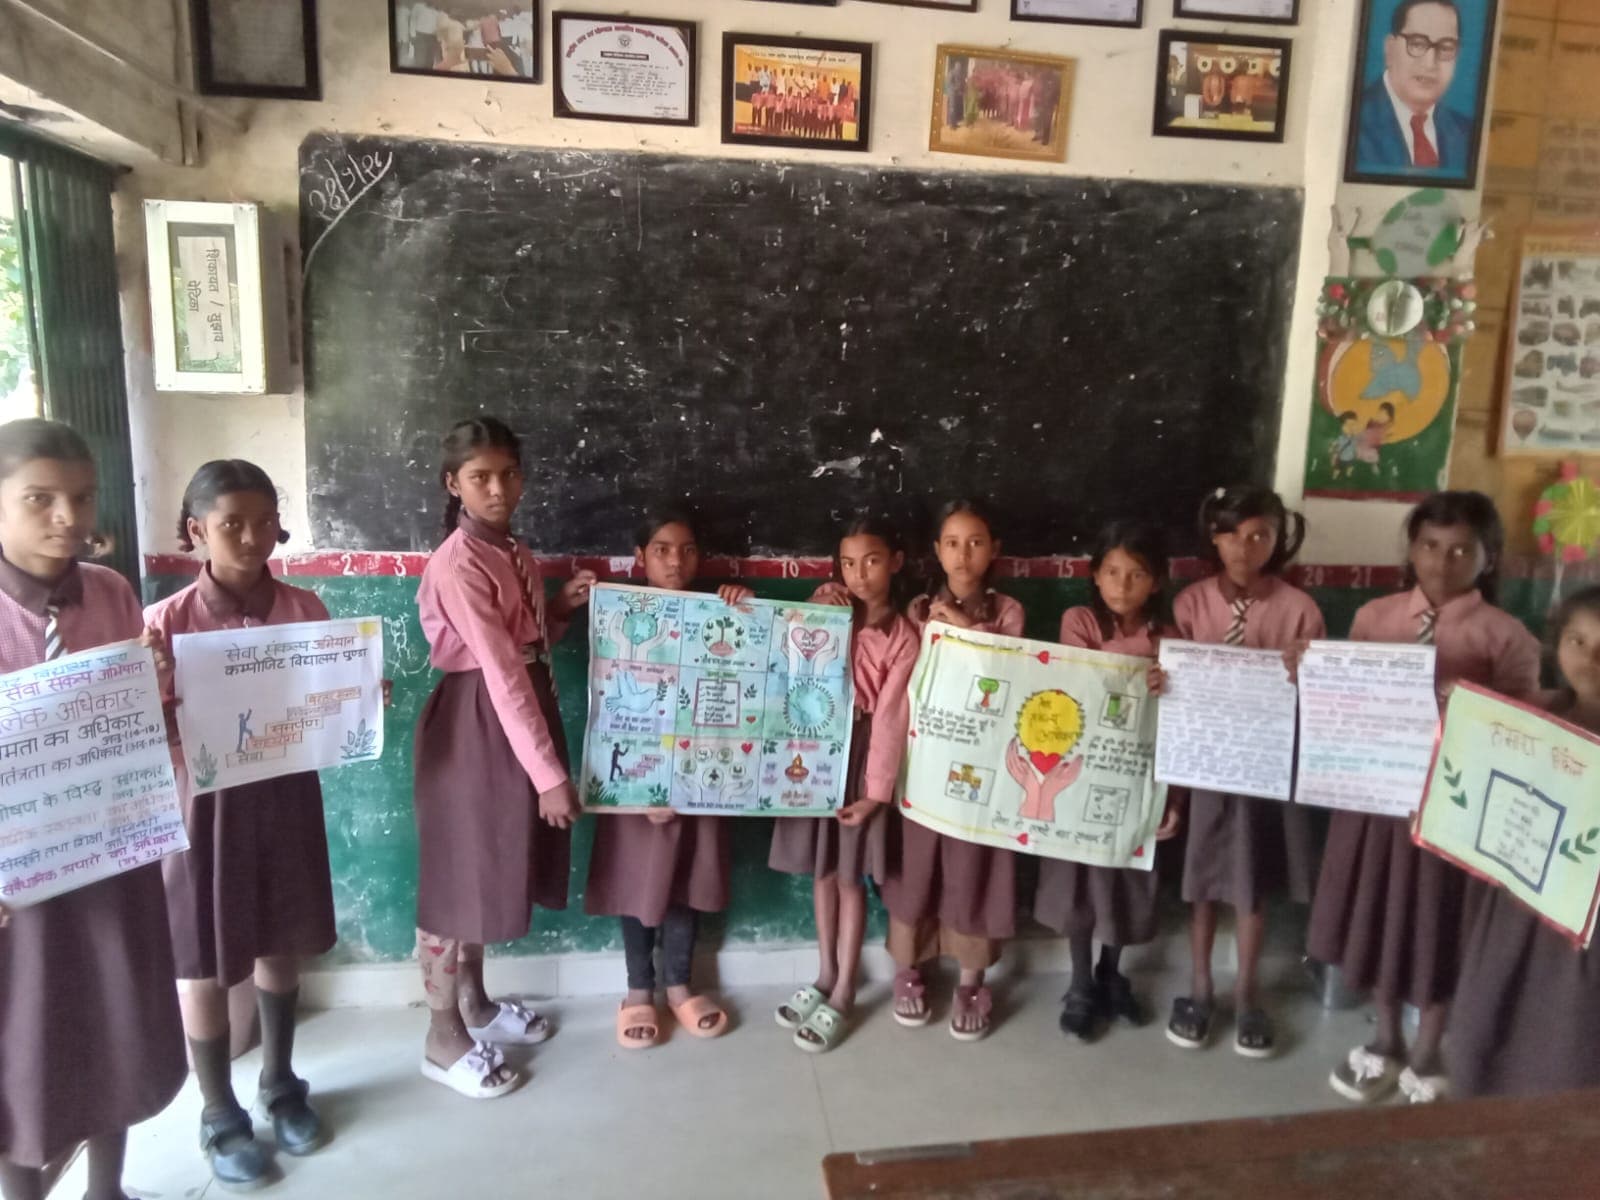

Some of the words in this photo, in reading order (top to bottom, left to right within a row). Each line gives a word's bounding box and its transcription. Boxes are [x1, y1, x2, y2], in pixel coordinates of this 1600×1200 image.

[206, 249, 220, 292] शिकायत
[187, 280, 202, 312] पेटिका
[207, 312, 224, 342] सुझाव
[340, 554, 355, 576] 2
[394, 555, 407, 577] 3
[782, 559, 800, 578] 10
[224, 643, 258, 662] सेवा
[0, 738, 38, 760] मता
[43, 729, 69, 747] का
[78, 711, 145, 739] अधिकार
[51, 757, 71, 773] का
[75, 744, 125, 766] अधिकार
